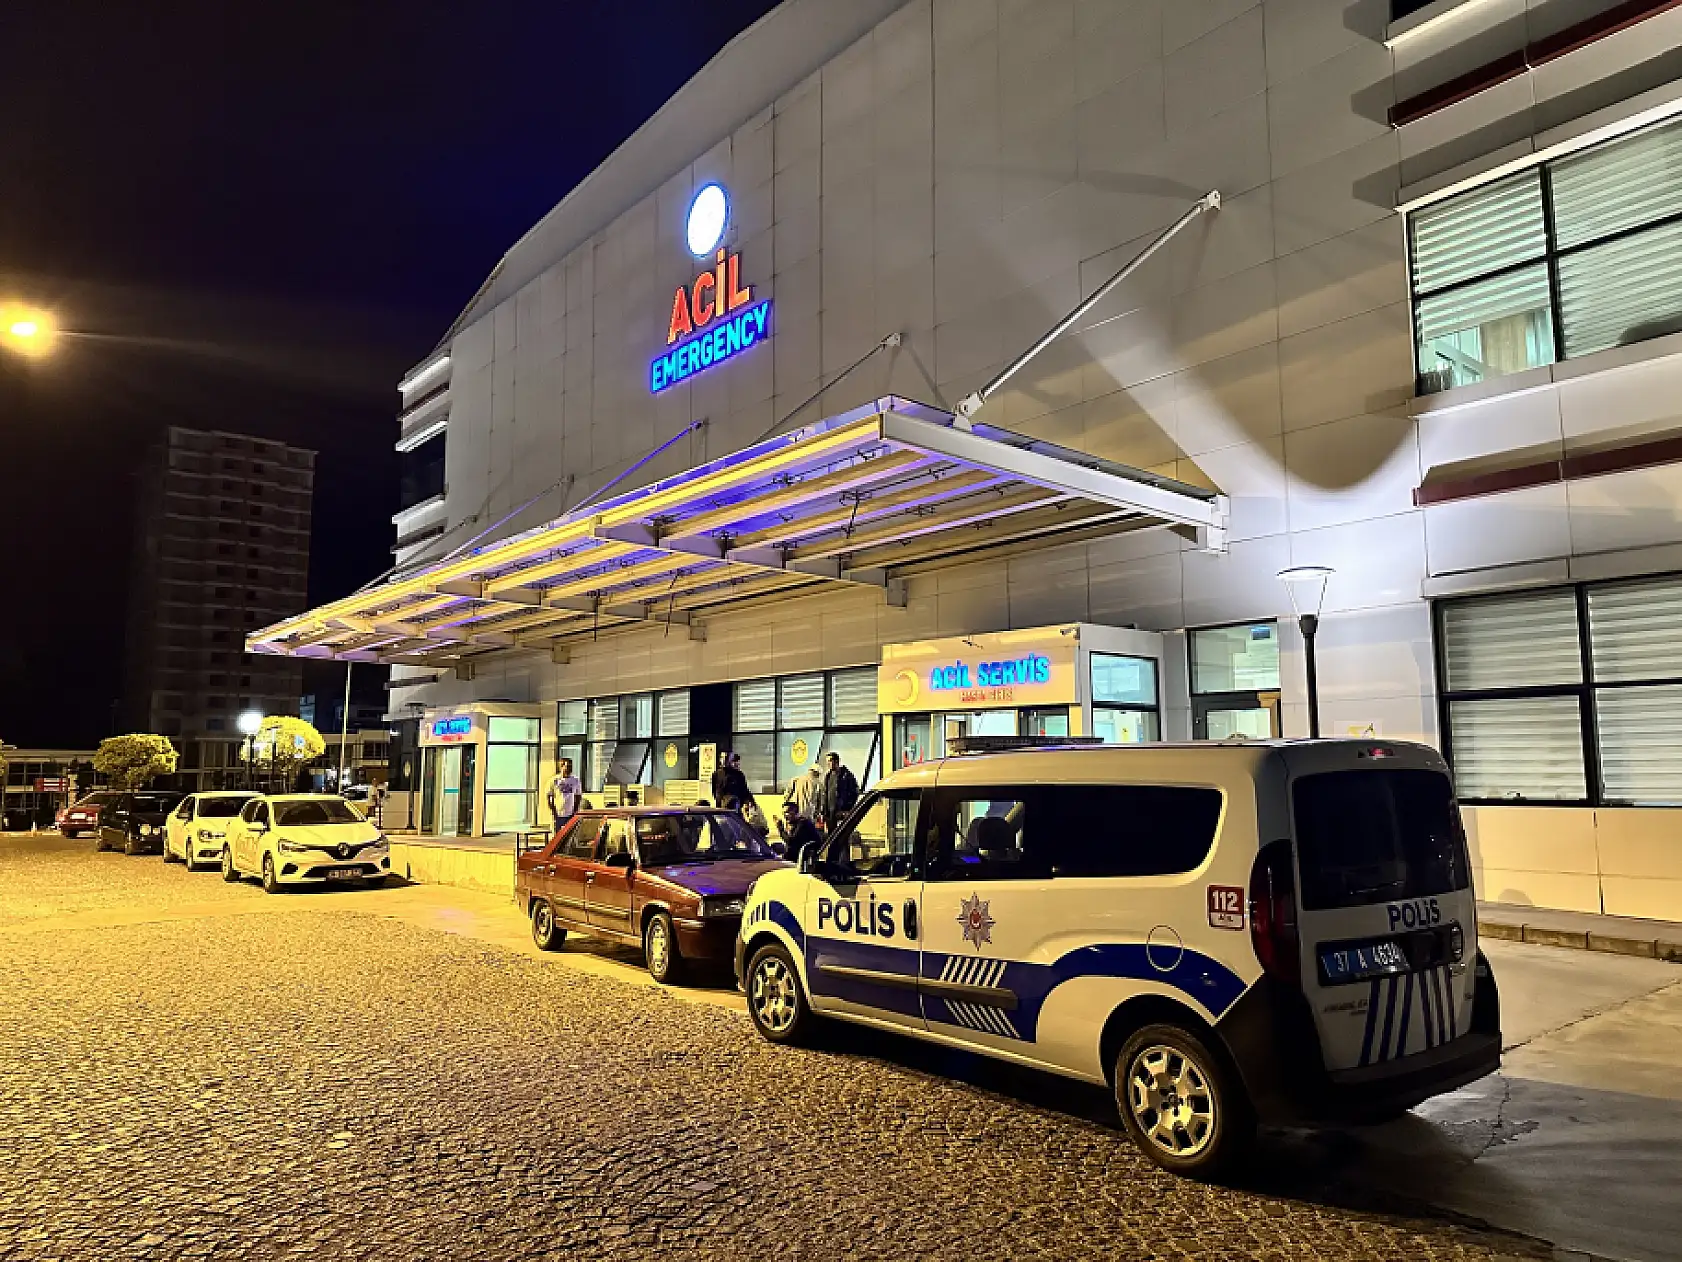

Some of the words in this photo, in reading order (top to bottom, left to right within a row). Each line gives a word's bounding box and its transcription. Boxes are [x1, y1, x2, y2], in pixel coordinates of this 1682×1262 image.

[667, 248, 750, 345] ACİL
[651, 301, 769, 392] EMERGENCY
[931, 660, 972, 690] ACİL
[977, 653, 1050, 687] SERVİS
[817, 891, 896, 938] POLİS
[1211, 889, 1240, 912] 112
[1386, 898, 1441, 932] POLİS
